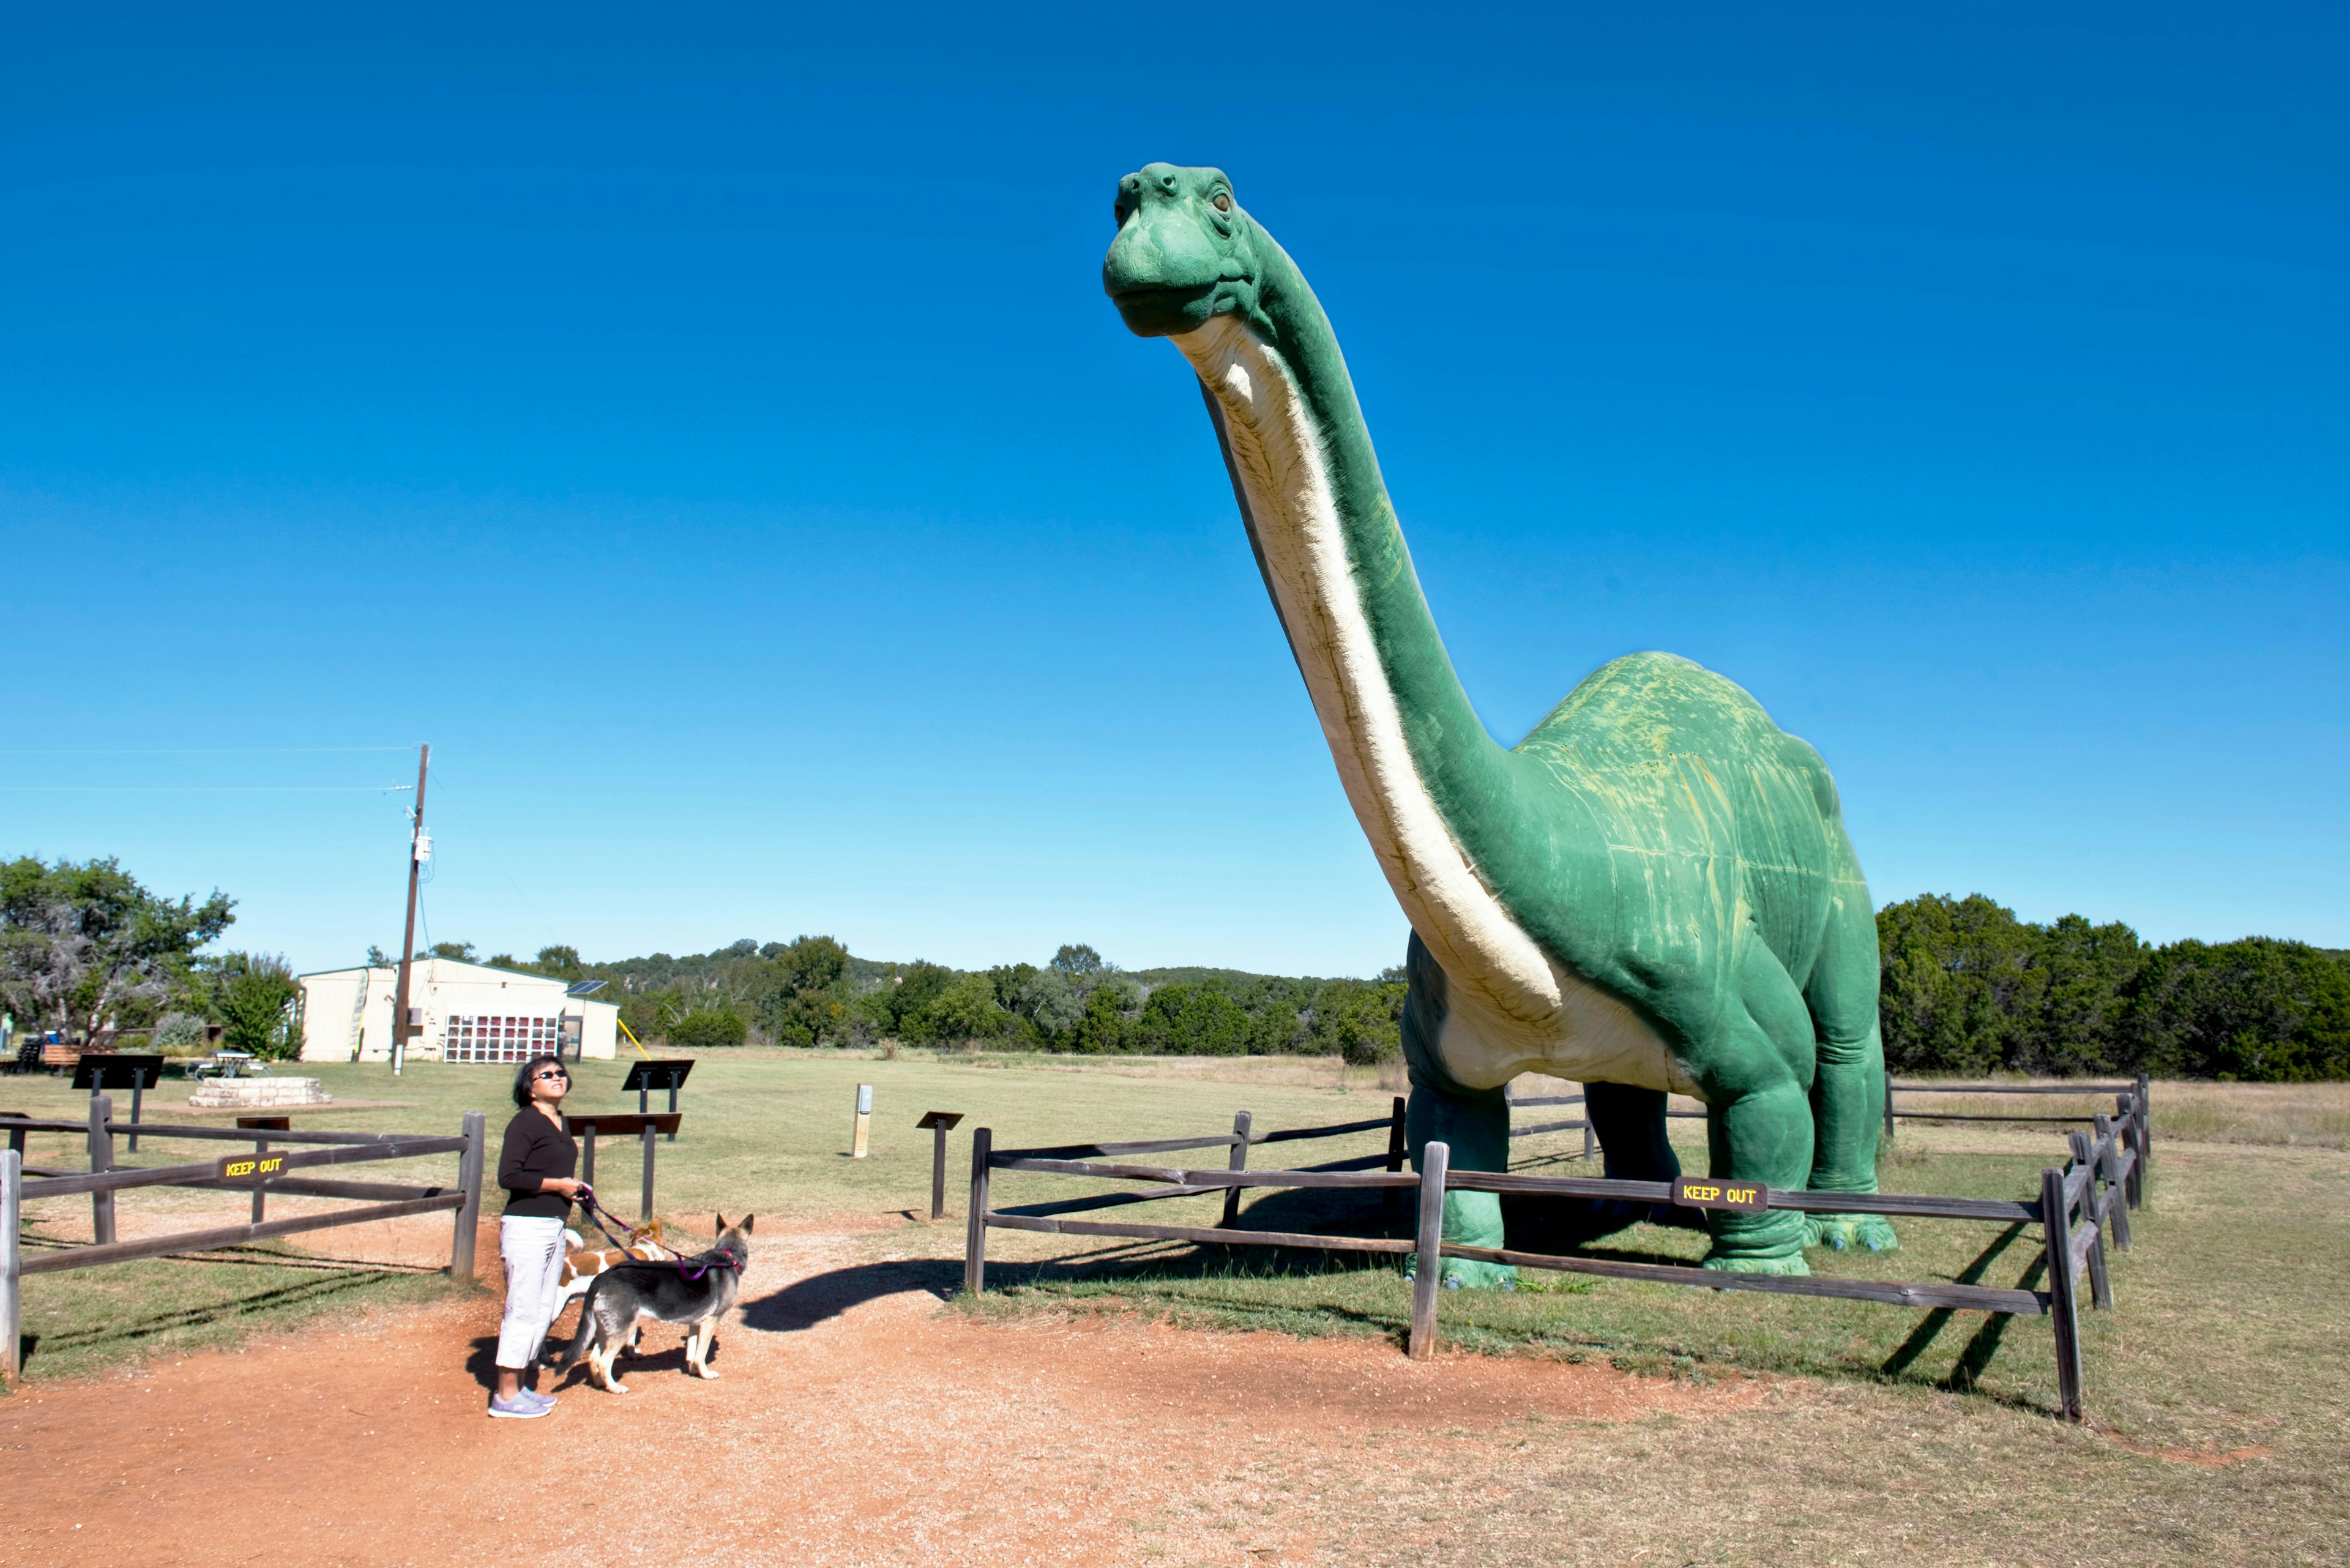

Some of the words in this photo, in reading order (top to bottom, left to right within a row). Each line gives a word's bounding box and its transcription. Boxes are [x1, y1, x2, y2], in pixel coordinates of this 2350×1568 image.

[226, 1161, 256, 1176] KEEP
[259, 1158, 283, 1173] OUT
[1684, 1185, 1720, 1201] KEEP
[1726, 1189, 1757, 1204] OUT
